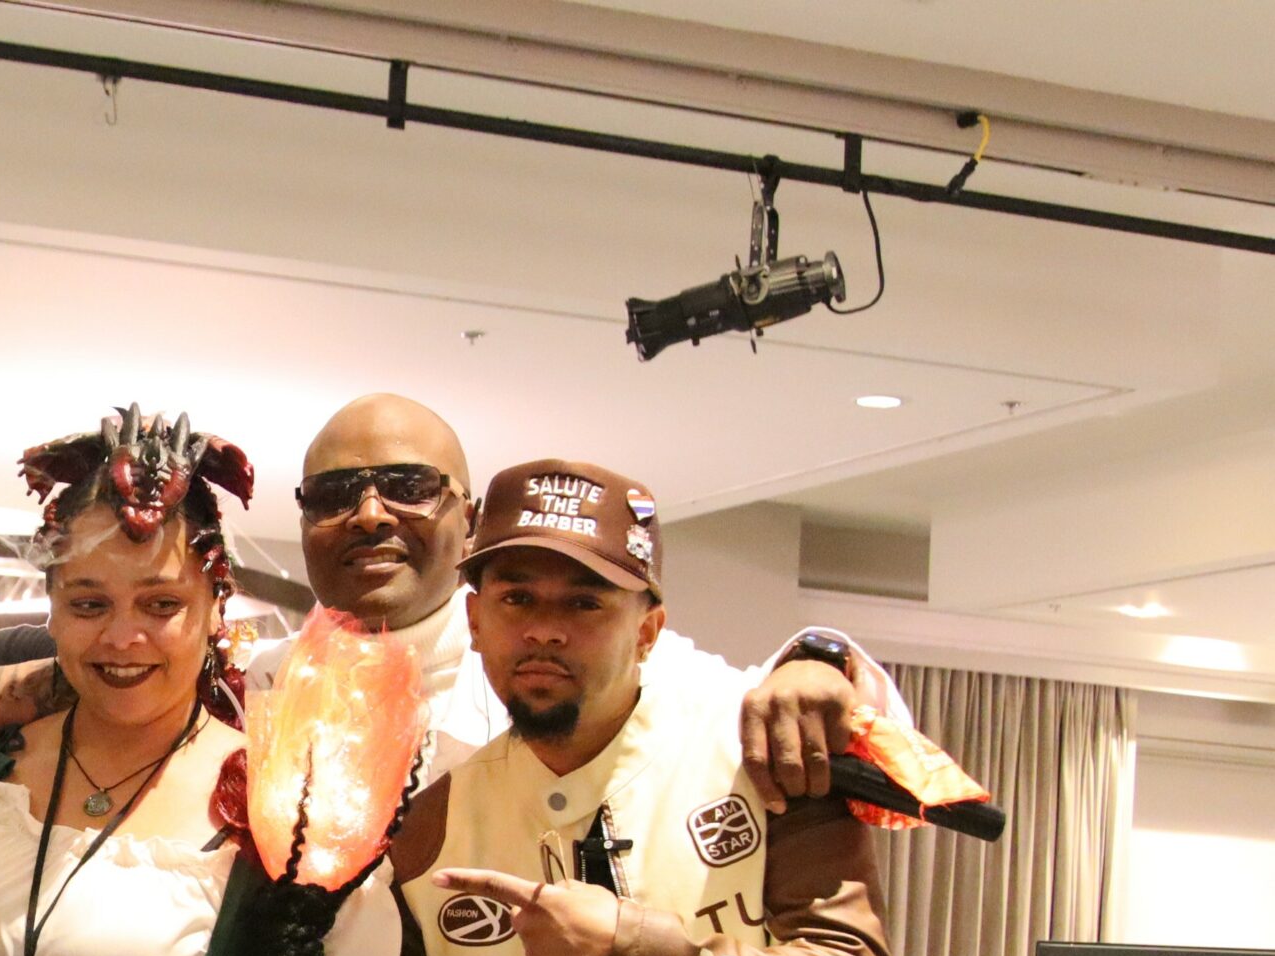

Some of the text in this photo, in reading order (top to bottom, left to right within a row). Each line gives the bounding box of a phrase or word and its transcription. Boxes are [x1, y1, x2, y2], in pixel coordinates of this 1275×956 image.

[527, 475, 604, 504] SALUTE
[542, 495, 582, 516] THE
[517, 510, 597, 538] BARBER
[698, 801, 738, 826] I AM
[708, 831, 752, 857] STAR
[446, 908, 479, 919] FASHION
